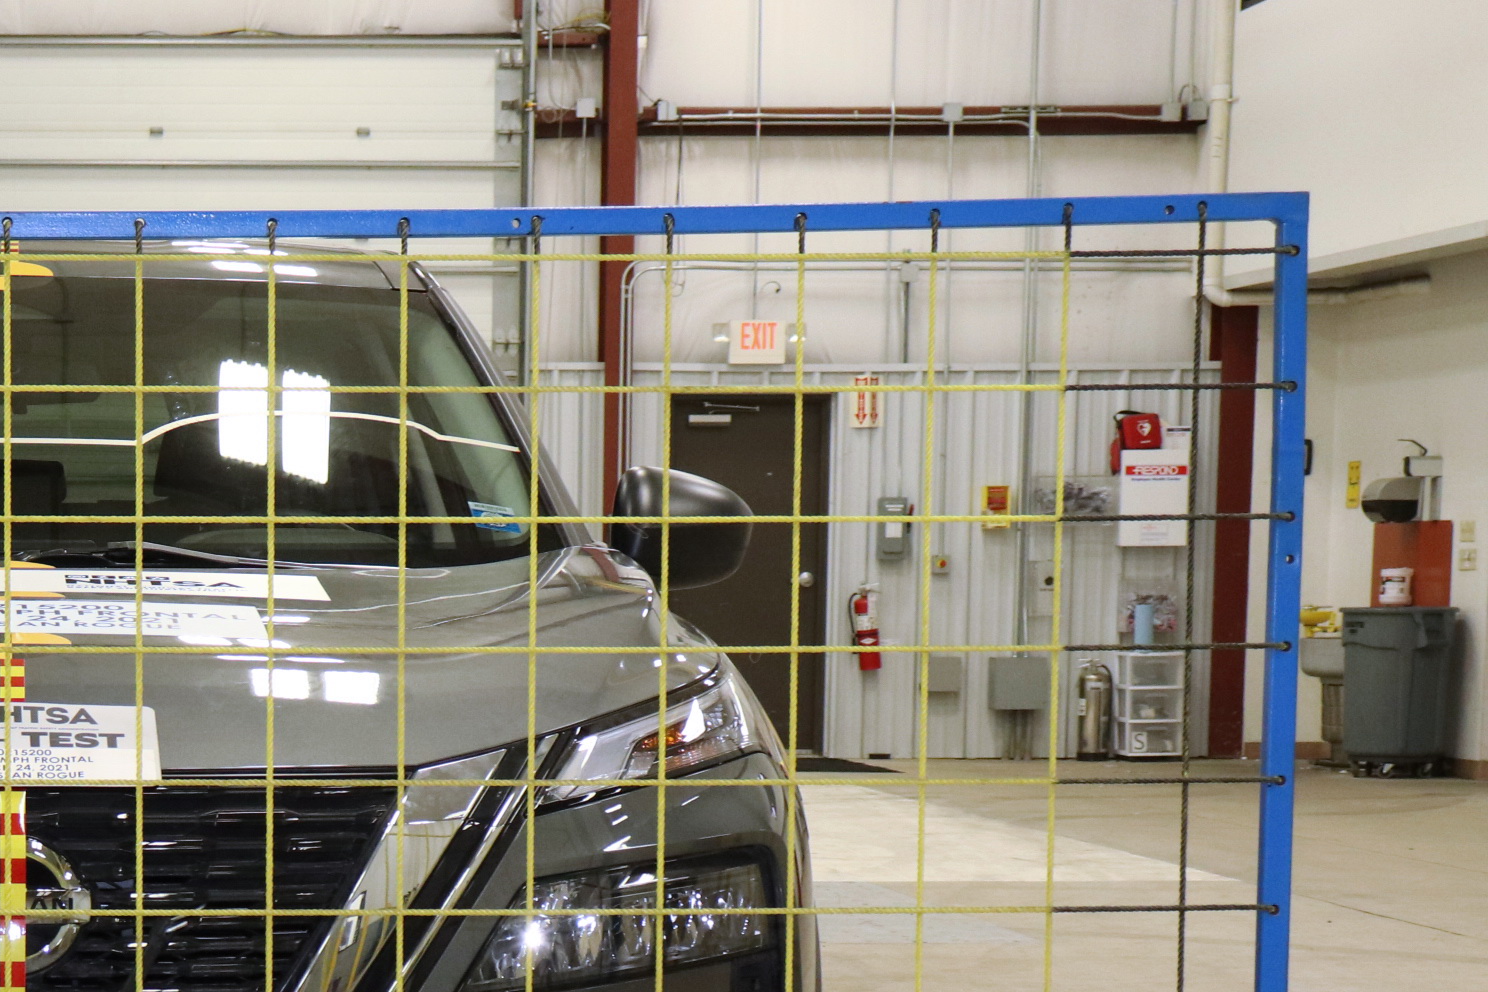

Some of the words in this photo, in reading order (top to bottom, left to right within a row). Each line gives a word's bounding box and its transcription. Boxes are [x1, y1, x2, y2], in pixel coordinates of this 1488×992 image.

[740, 322, 777, 350] EXIT
[65, 578, 244, 588] NHTSA
[78, 610, 247, 620] FRONTAL
[95, 616, 179, 624] 2021
[21, 732, 125, 748] TEST
[1133, 733, 1145, 750] S
[37, 771, 85, 779] ROGUE
